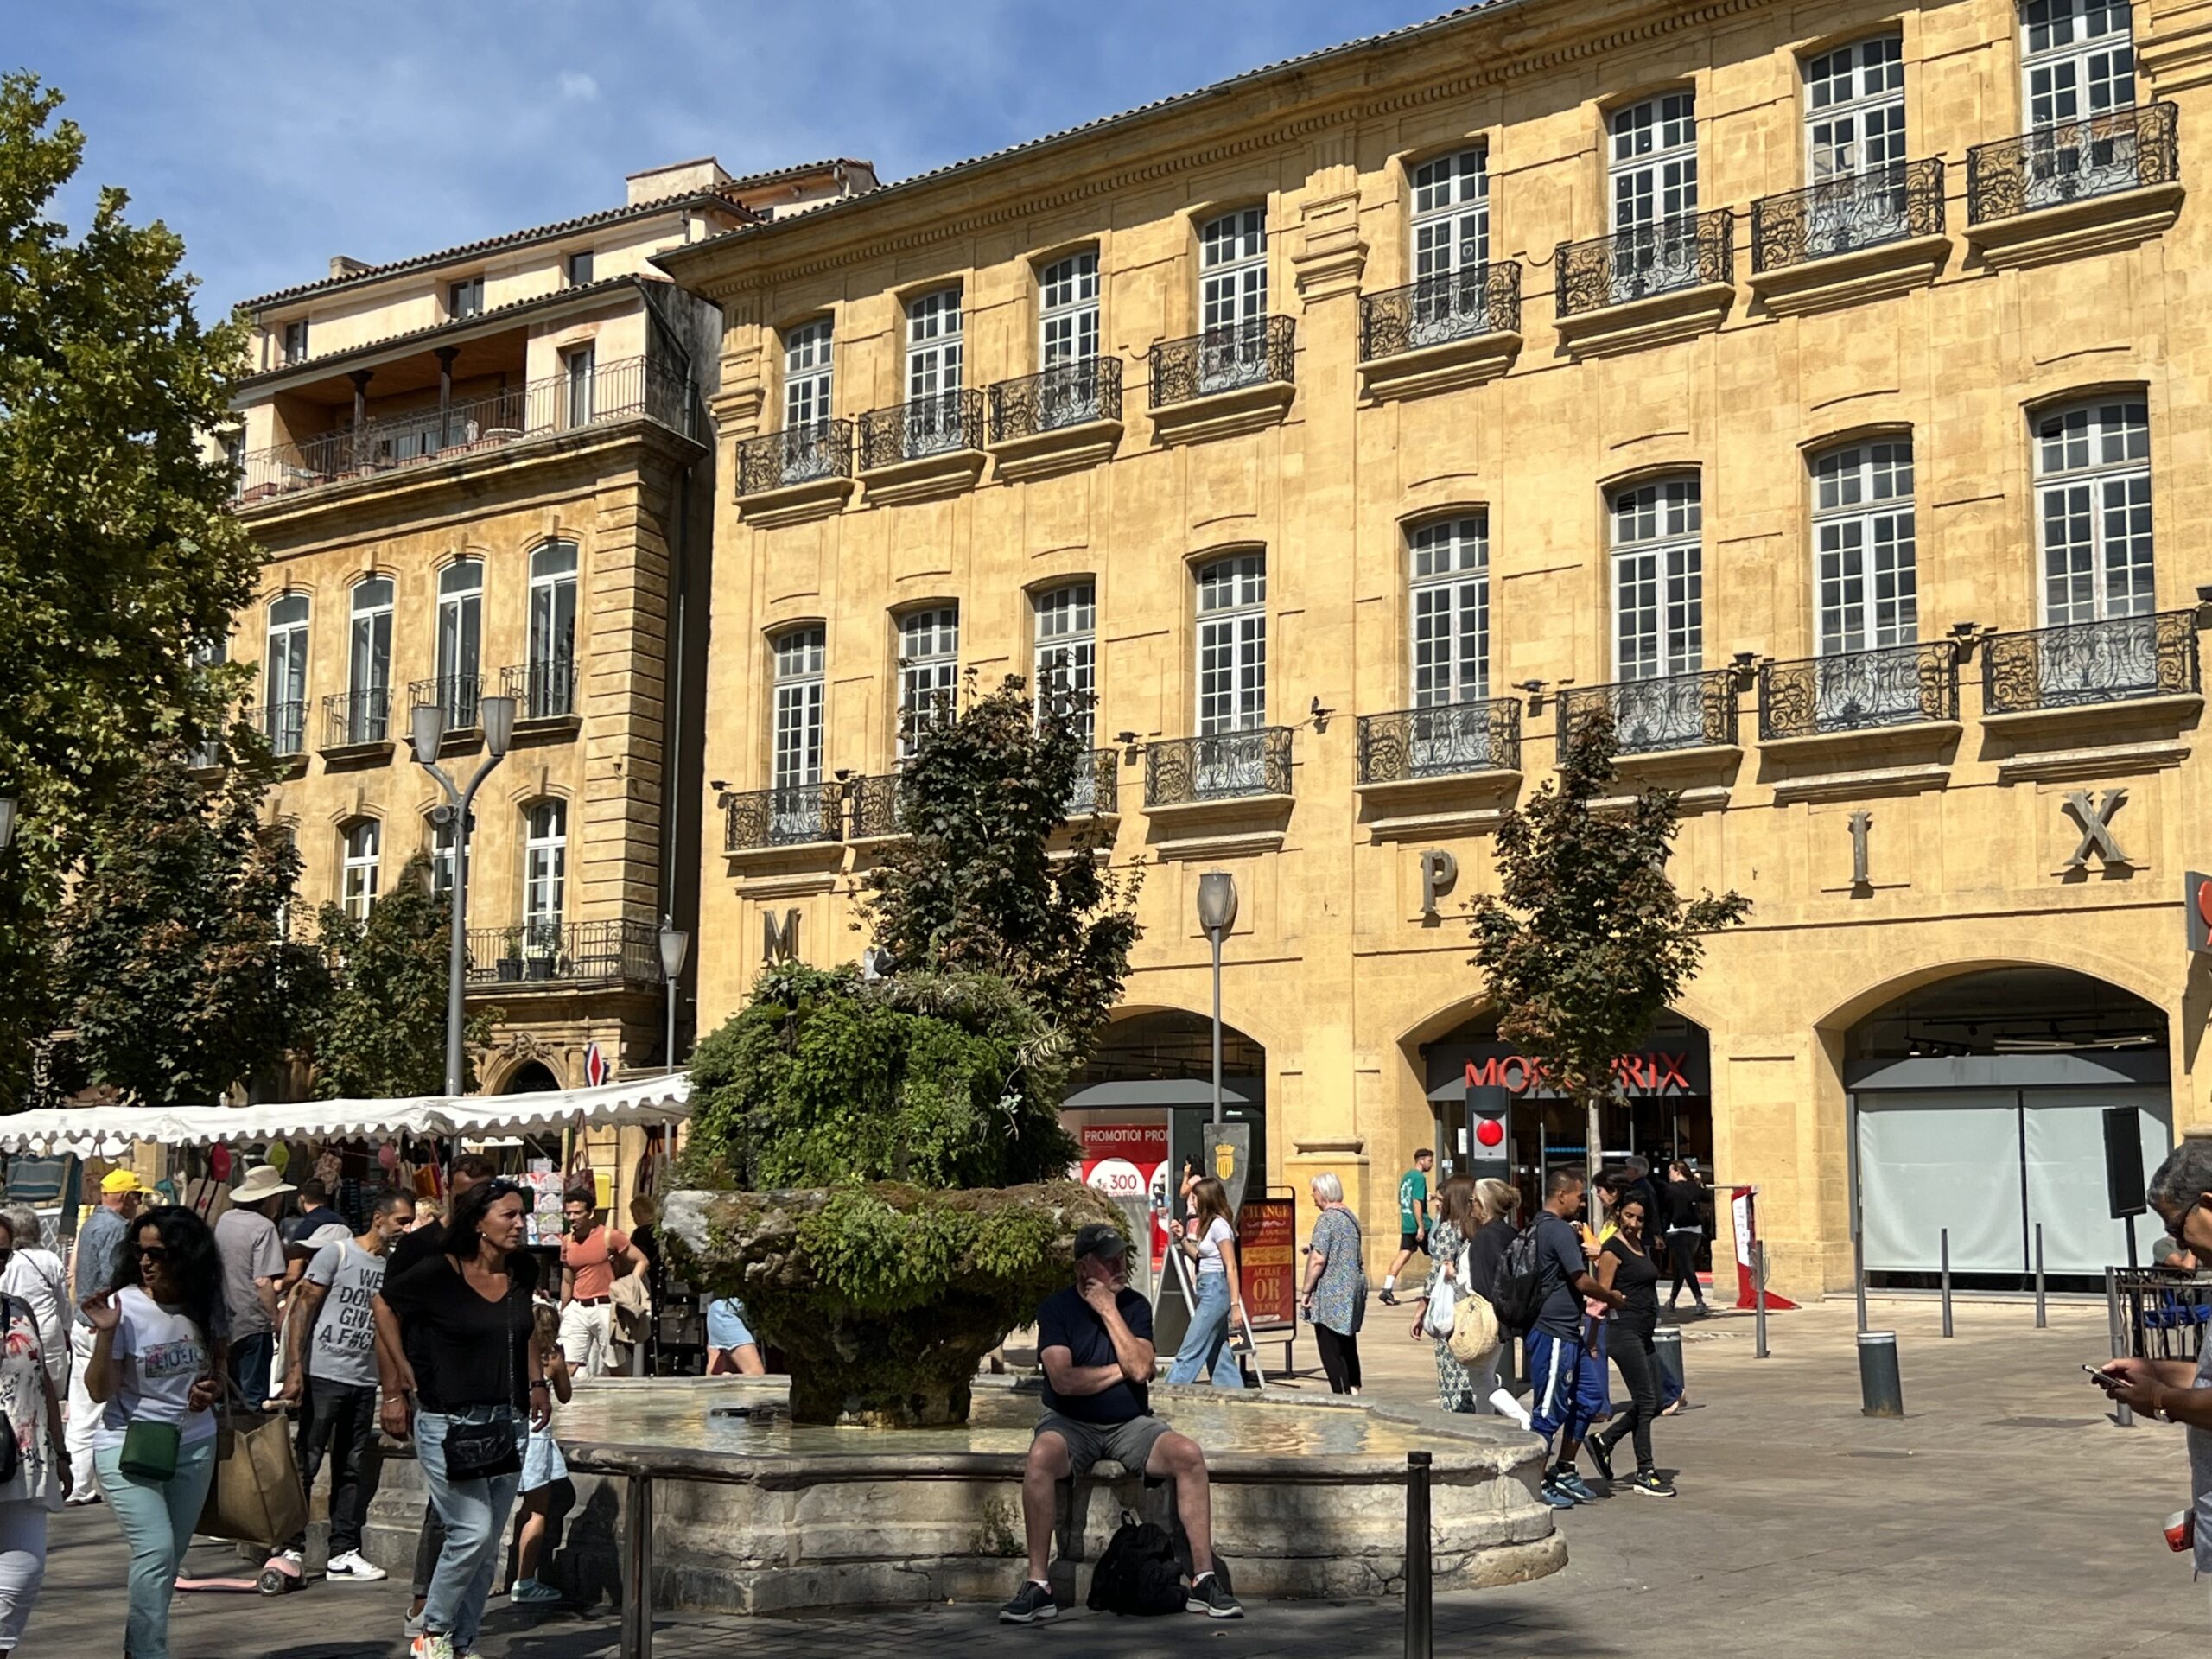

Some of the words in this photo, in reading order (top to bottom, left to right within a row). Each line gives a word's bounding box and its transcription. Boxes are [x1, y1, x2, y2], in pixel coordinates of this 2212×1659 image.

[1465, 1052, 1689, 1093] MONRIX
[1145, 1129, 1168, 1141] PRO
[1110, 1174, 1137, 1190] 300
[1241, 1205, 1290, 1218] CHANGE
[360, 1268, 385, 1289] WE
[1253, 1267, 1281, 1277] ACHAT
[340, 1286, 373, 1307] DON
[1253, 1278, 1280, 1301] OR
[1253, 1303, 1280, 1313] VENTE
[340, 1307, 375, 1330] GIVE
[318, 1325, 333, 1343] A
